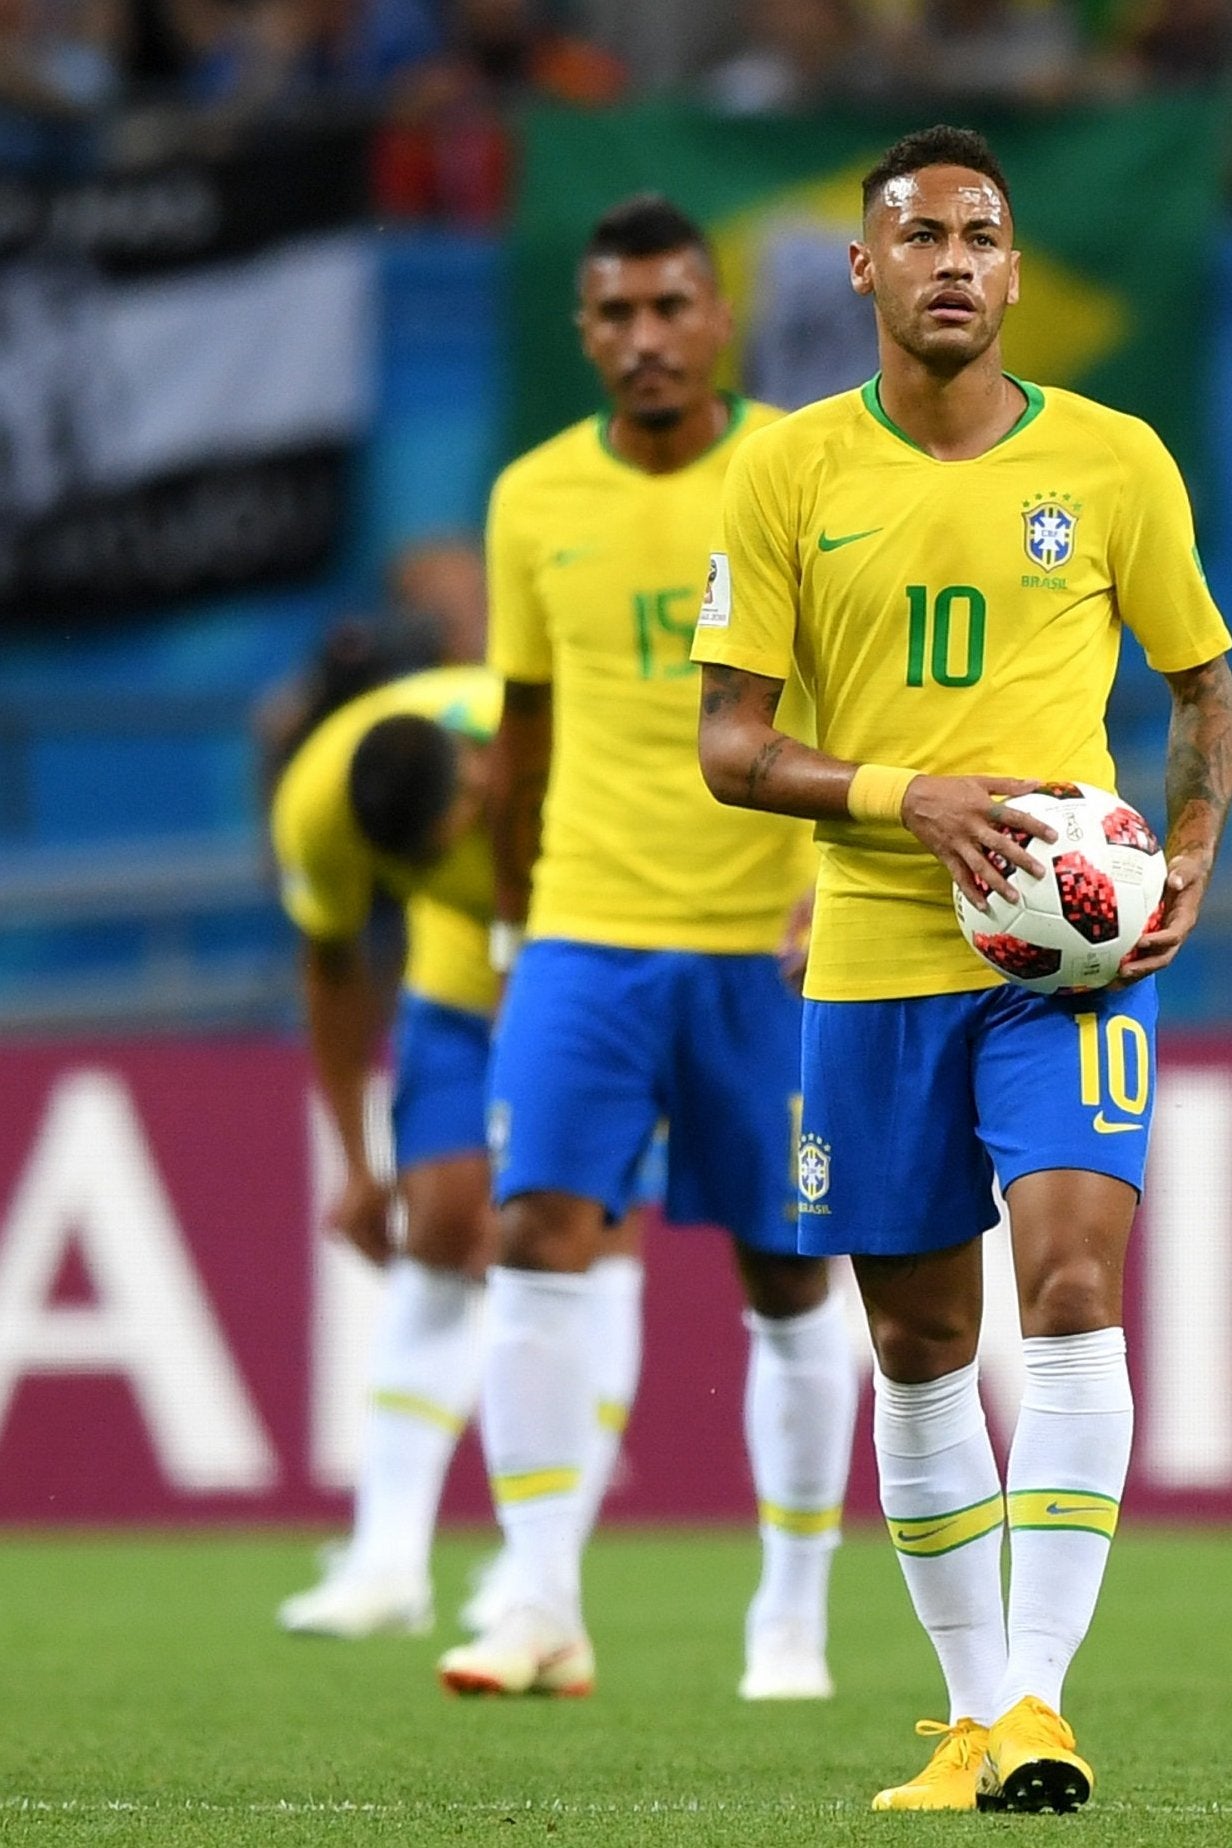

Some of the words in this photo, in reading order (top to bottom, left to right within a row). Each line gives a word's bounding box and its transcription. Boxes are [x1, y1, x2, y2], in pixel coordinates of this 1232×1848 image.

[1020, 574, 1068, 590] BRASIL
[632, 587, 698, 680] 15
[905, 585, 986, 688] 10
[1074, 1011, 1149, 1115] 10
